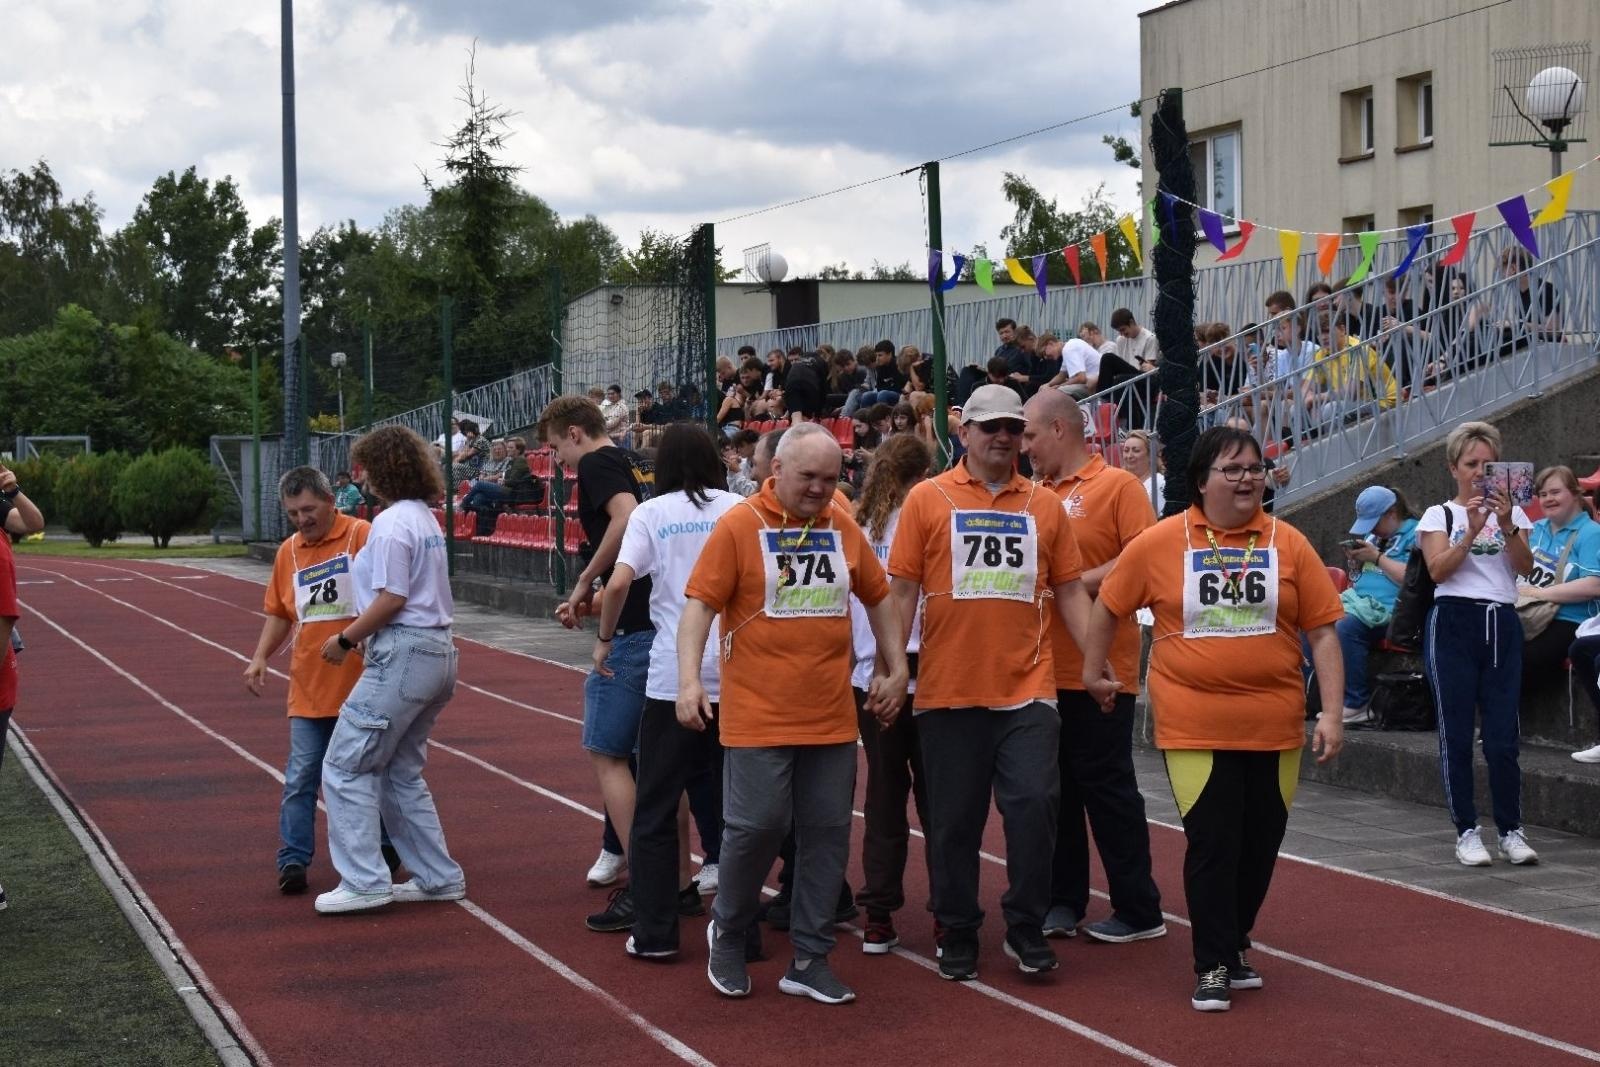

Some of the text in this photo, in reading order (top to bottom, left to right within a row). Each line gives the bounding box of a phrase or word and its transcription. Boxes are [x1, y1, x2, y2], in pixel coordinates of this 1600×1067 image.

[963, 535, 1024, 568] 785
[776, 553, 836, 586] 574
[1524, 566, 1555, 588] 02
[310, 578, 338, 605] 78
[1199, 571, 1266, 605] 646
